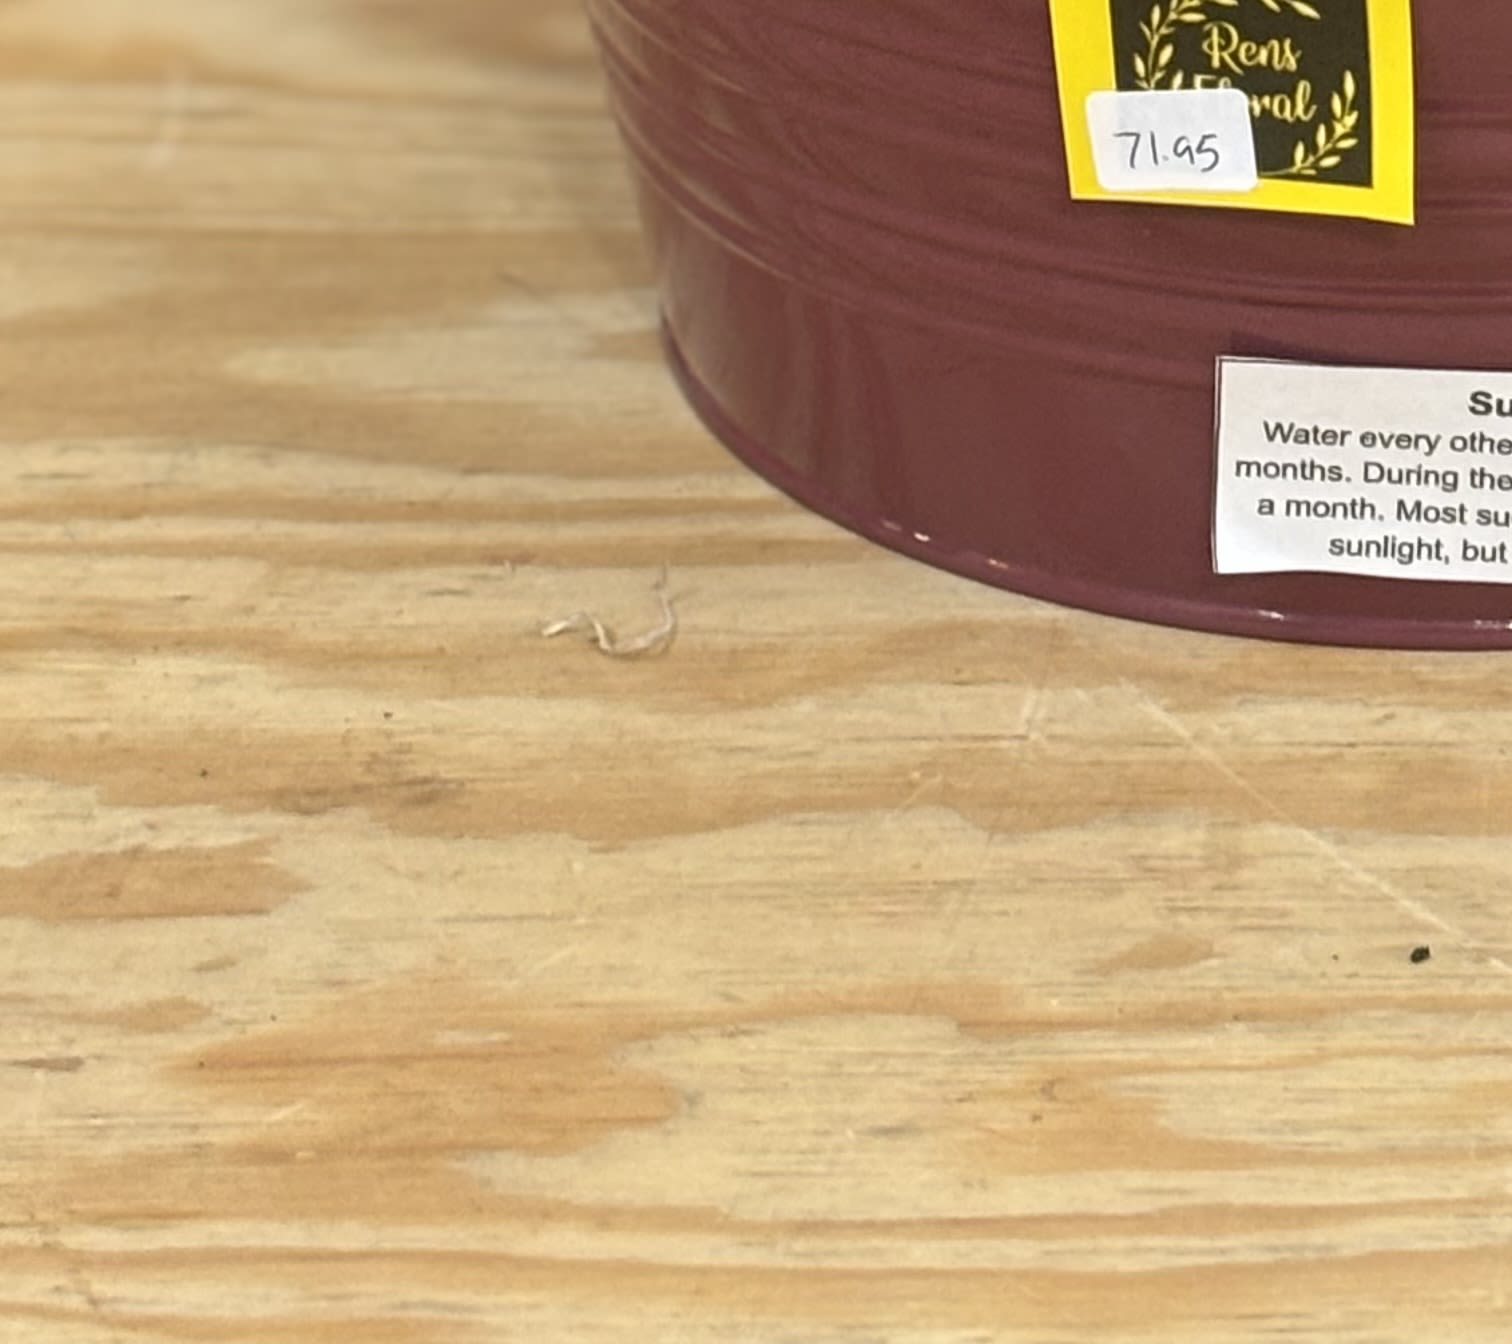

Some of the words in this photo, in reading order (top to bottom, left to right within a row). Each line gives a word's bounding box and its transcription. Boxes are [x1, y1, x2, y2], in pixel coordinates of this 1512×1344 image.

[1202, 21, 1302, 75] Rens
[1192, 73, 1319, 123] ral
[1113, 131, 1220, 172] 71.95
[1263, 421, 1351, 446] Water
[1359, 431, 1441, 456] every
[1235, 459, 1351, 482] months.
[1363, 461, 1458, 493] During
[1257, 498, 1275, 515] a
[1285, 497, 1384, 519] month.
[1396, 499, 1466, 524] Most
[1329, 535, 1449, 565] sunlight,
[1462, 539, 1507, 563] but
